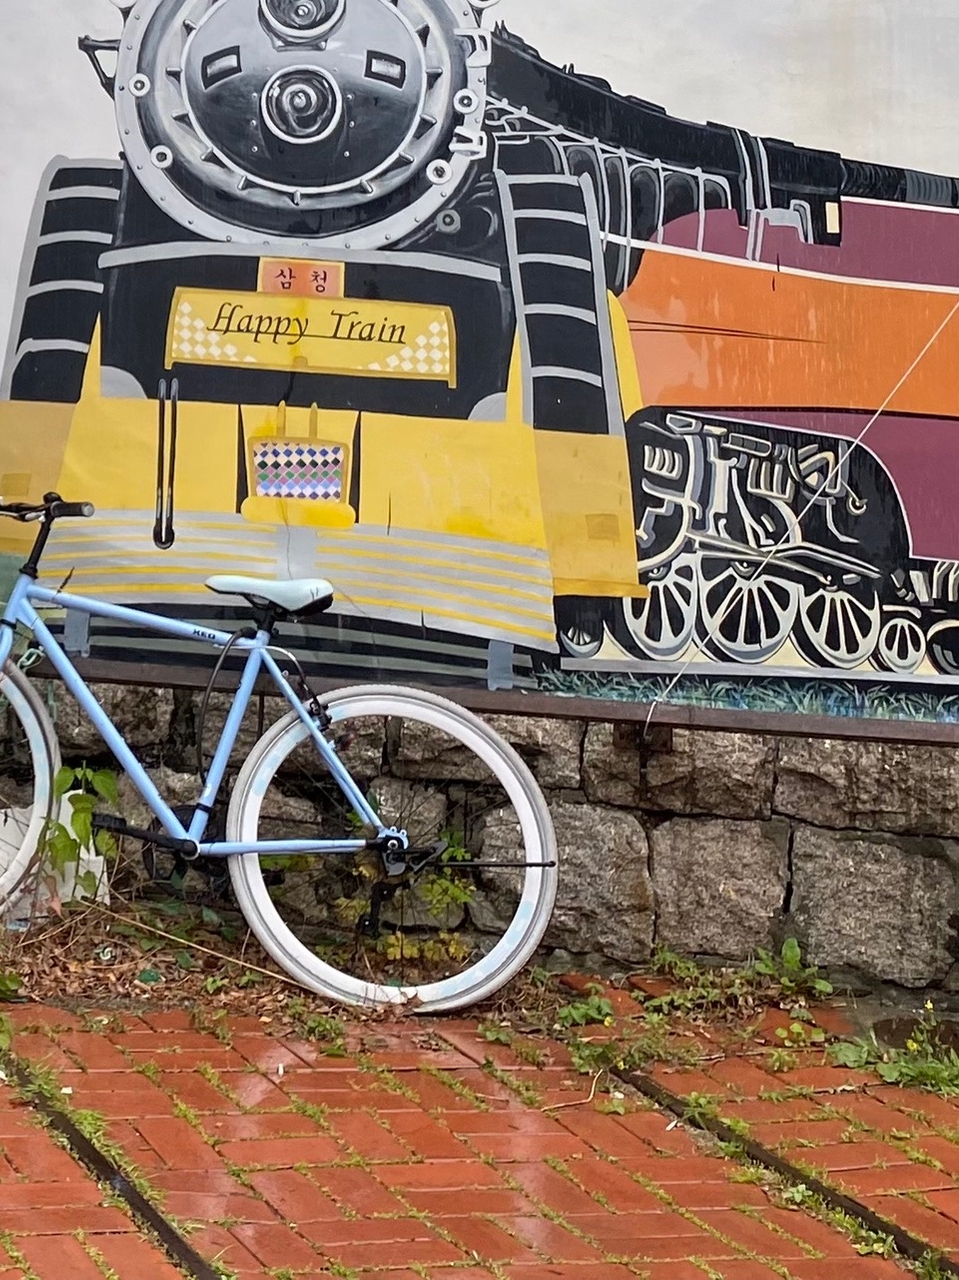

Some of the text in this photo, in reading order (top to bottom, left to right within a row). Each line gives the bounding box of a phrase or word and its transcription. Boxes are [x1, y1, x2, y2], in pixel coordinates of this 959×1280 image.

[275, 267, 328, 293] 삼청
[208, 302, 407, 345] Happy Train
